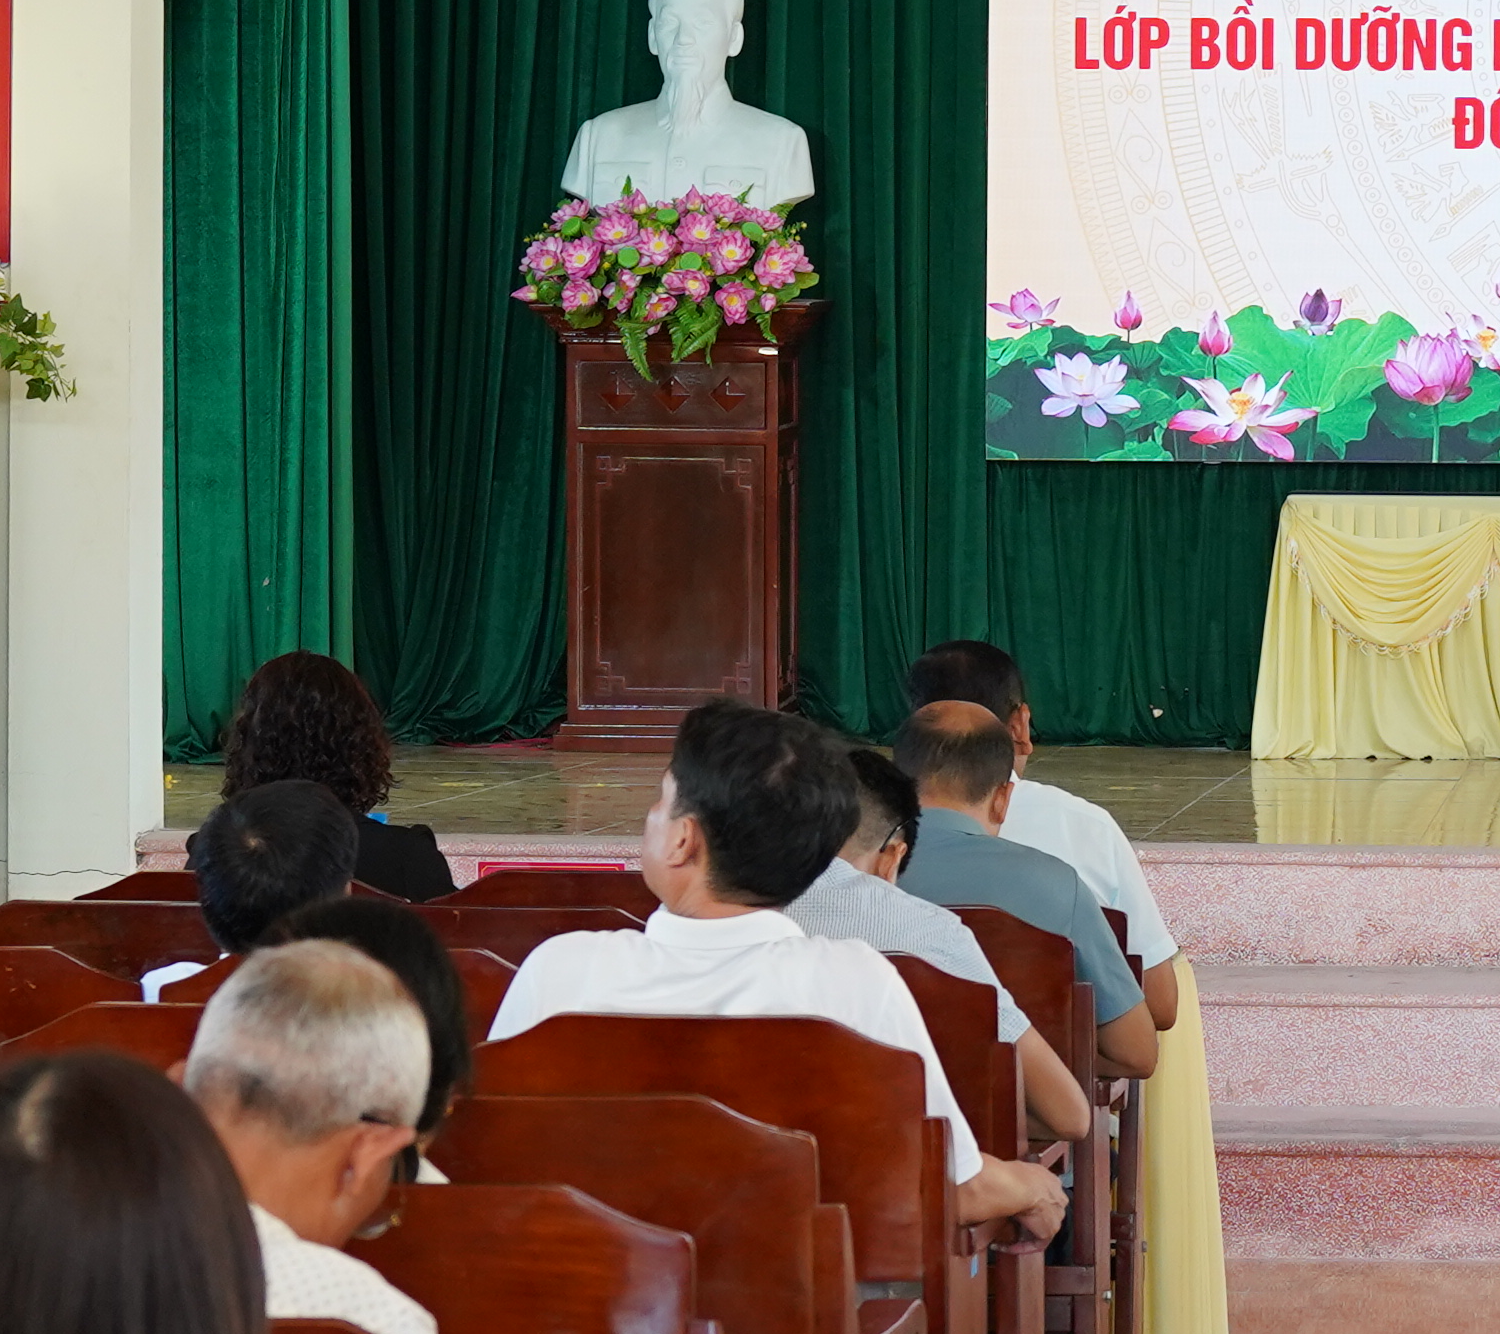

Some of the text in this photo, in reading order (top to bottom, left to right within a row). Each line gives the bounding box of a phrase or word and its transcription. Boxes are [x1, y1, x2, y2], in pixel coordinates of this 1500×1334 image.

[1075, 6, 1170, 70] LỚP
[1190, 0, 1274, 70] BỒI
[1296, 6, 1472, 71] DƯỠNG
